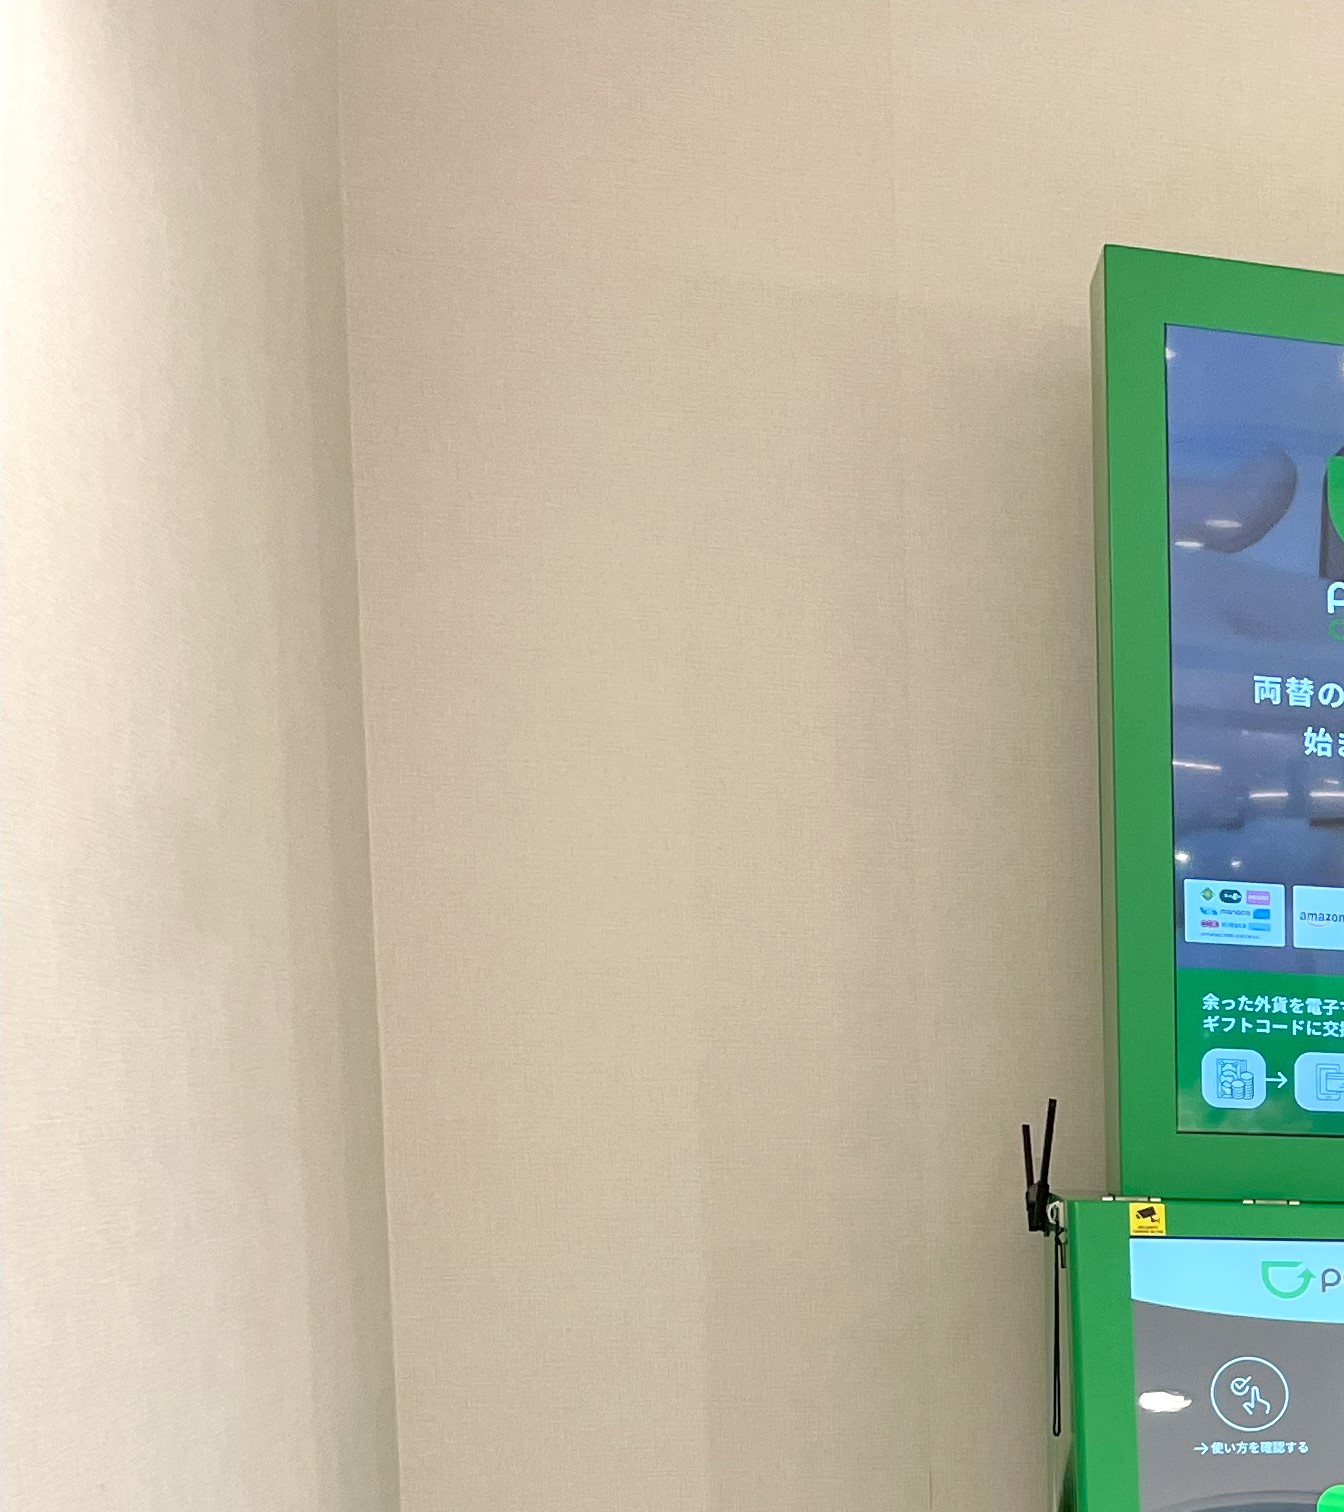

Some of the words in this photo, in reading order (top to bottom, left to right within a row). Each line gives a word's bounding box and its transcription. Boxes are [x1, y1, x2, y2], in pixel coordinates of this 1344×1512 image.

[1300, 910, 1344, 925] amazon
[1210, 1440, 1309, 1455] 使い方を確認する
